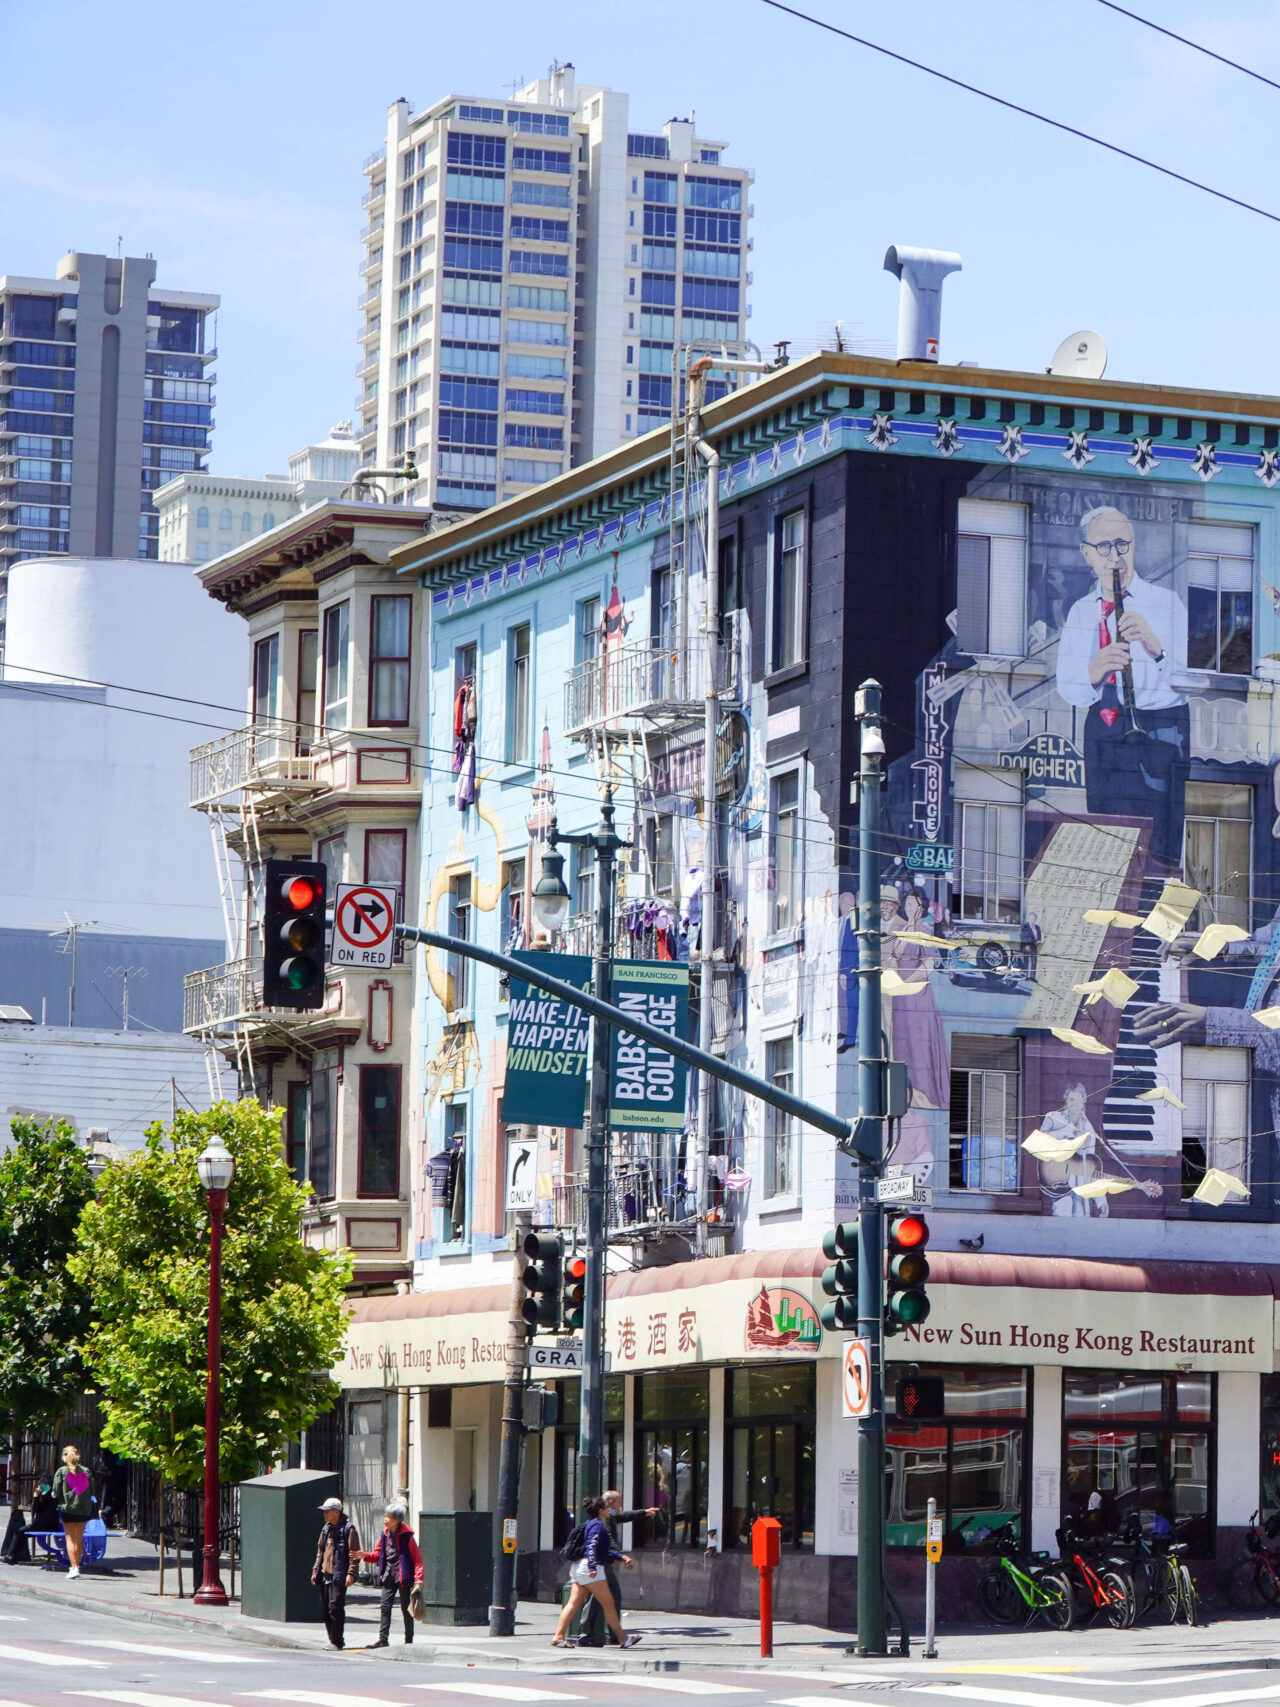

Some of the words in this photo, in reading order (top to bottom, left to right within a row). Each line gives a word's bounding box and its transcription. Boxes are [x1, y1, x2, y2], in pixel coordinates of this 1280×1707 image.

[929, 675, 941, 755] MULIN
[926, 765, 938, 830] ROUGE
[338, 949, 354, 961] ON
[362, 951, 386, 963] RED
[618, 970, 634, 978] SAN
[636, 971, 678, 981] FRANCISCO
[509, 999, 589, 1027] MAKE-IT-
[512, 1024, 590, 1052] HAPPEN
[646, 994, 677, 1102] COLLGE
[507, 1047, 587, 1076] MINDSET
[623, 1114, 664, 1123] babson.edu
[510, 1190, 532, 1204] ONLY
[836, 1195, 849, 1204] Bill
[880, 1181, 910, 1196] BROADWAY
[560, 1339, 575, 1347] 1200
[600, 1306, 697, 1360] 港酒家
[903, 1323, 953, 1344] New
[960, 1322, 1002, 1346] Sun
[1010, 1325, 1069, 1354] Hong
[1075, 1328, 1133, 1356] Kong
[1139, 1330, 1255, 1355] Restaurant
[350, 1346, 373, 1370] New
[378, 1343, 398, 1369] Sun
[403, 1343, 432, 1373] Hong
[437, 1340, 466, 1370] Kong
[471, 1337, 509, 1364] Restau
[535, 1350, 588, 1368] GRA
